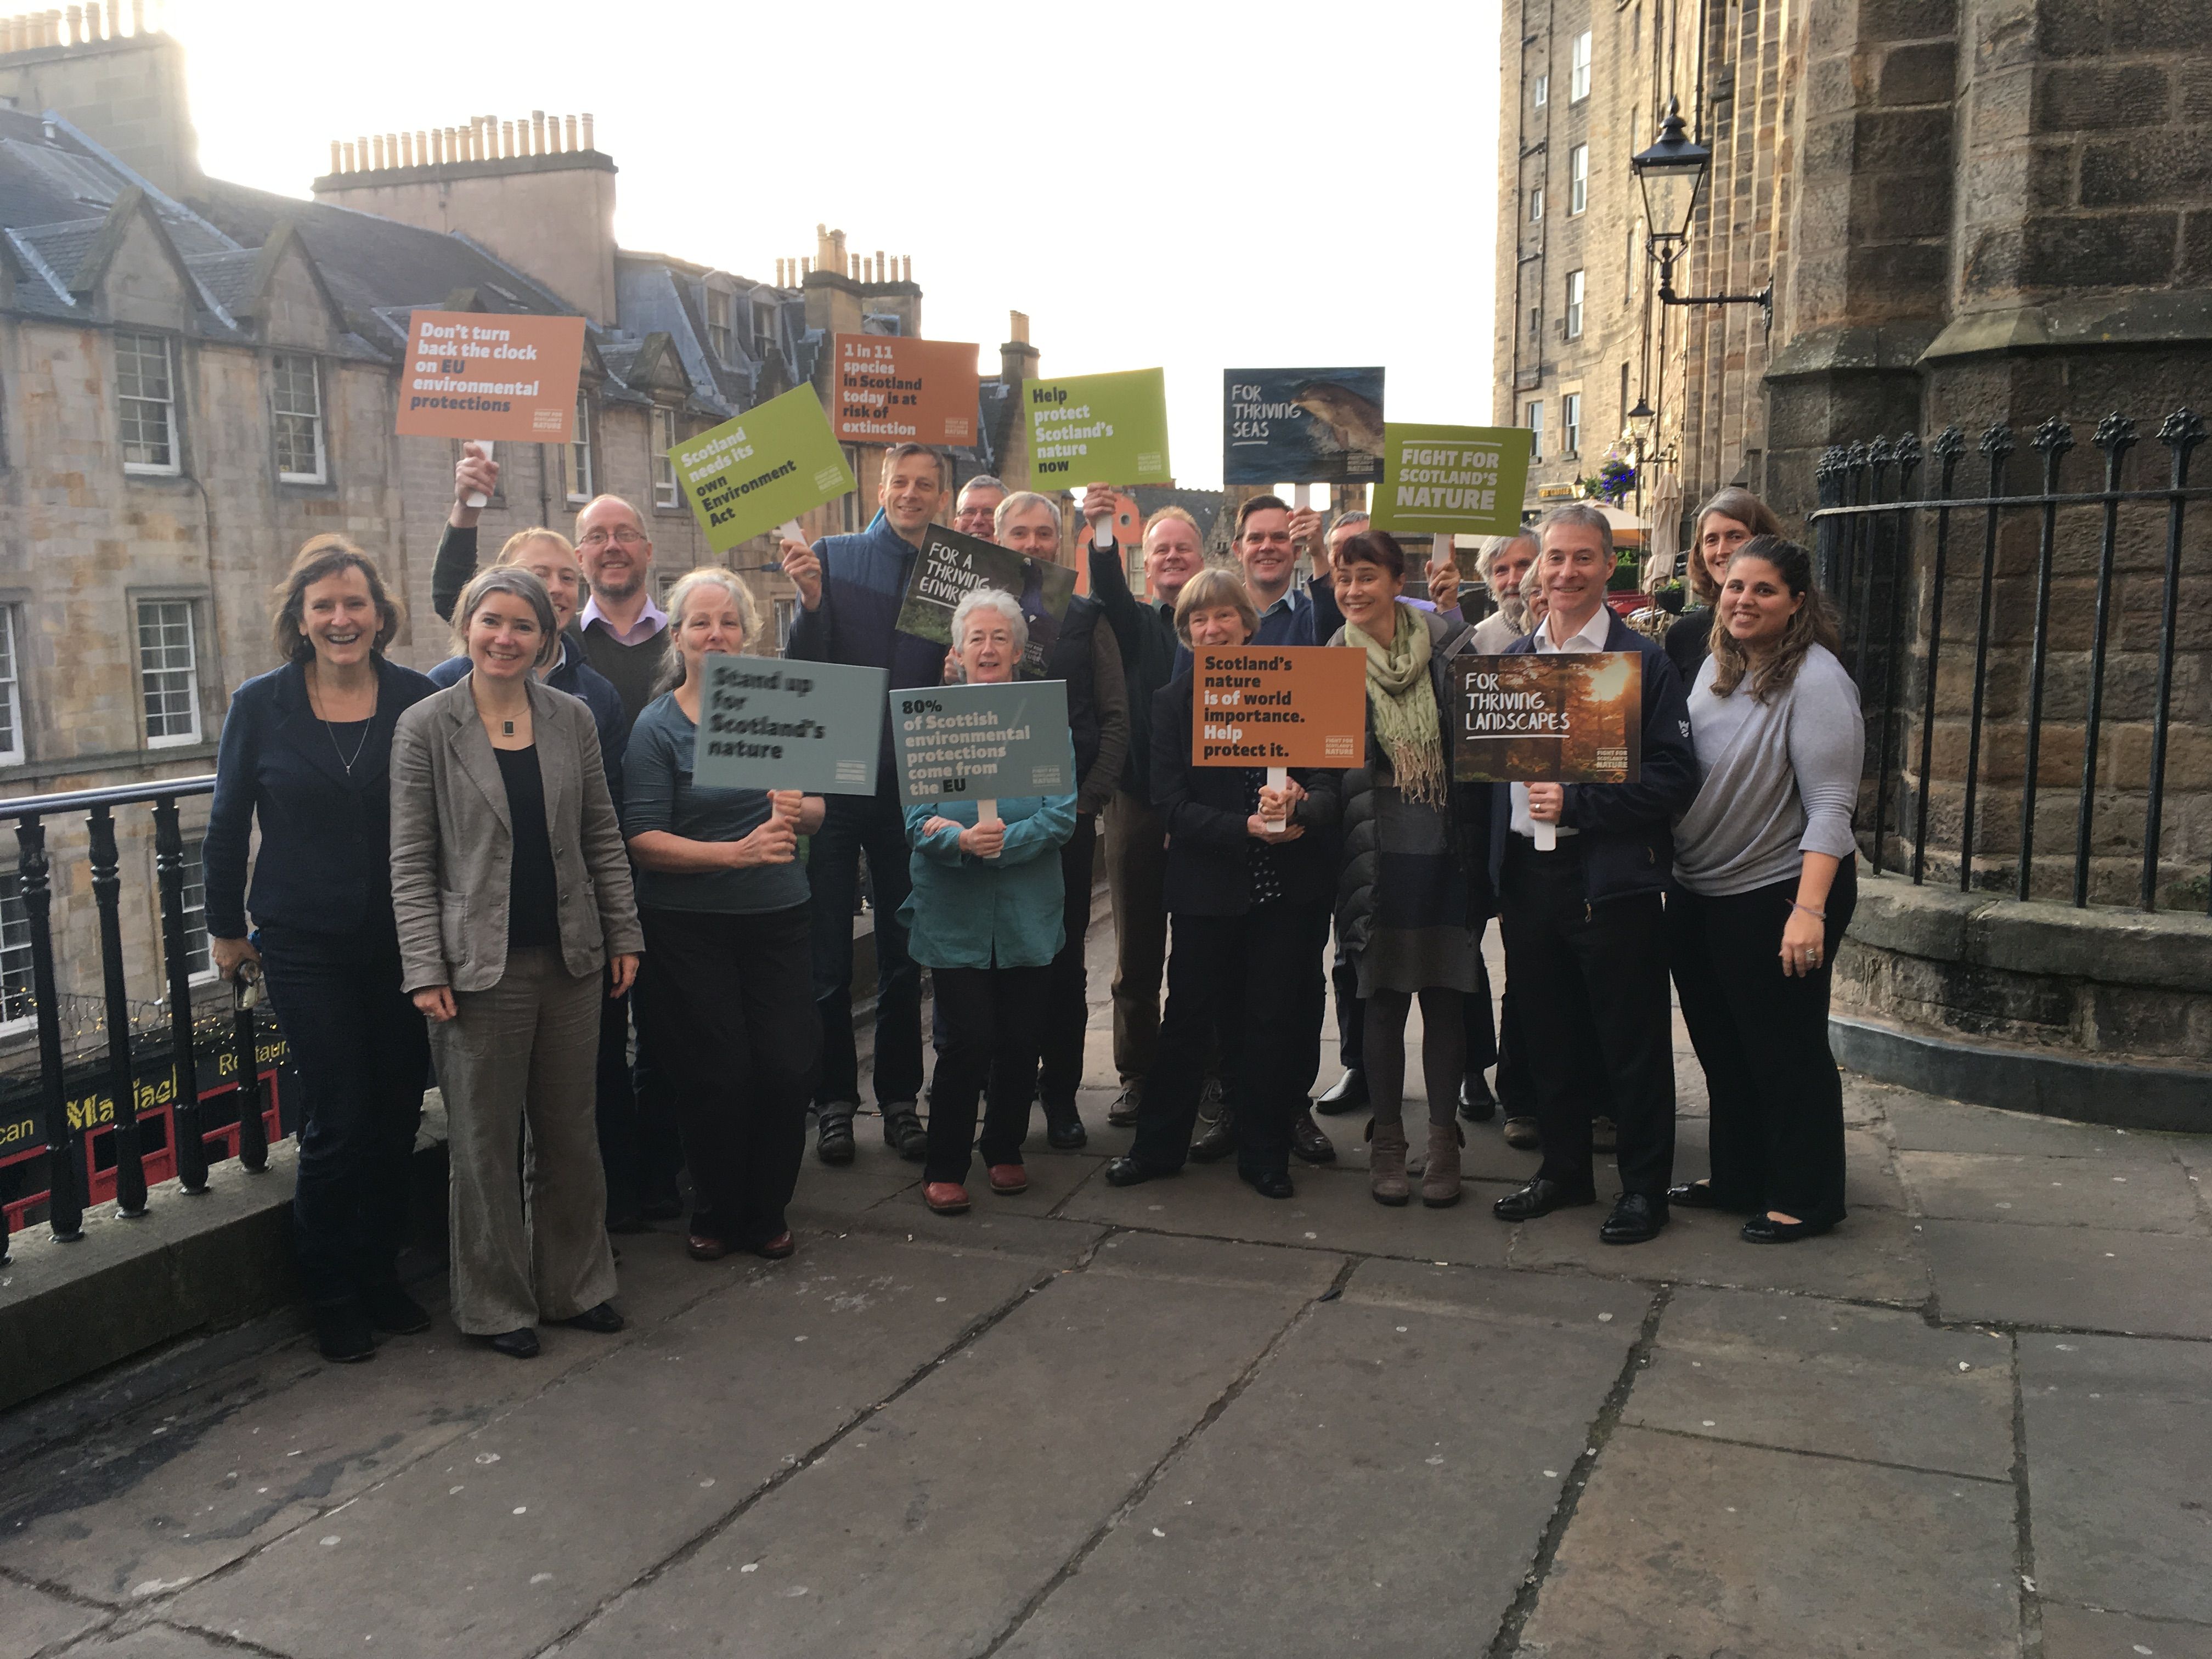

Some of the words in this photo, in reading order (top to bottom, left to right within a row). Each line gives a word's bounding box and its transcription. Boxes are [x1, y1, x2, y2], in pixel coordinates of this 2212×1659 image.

[421, 322, 469, 339] Don't
[472, 327, 510, 341] turn
[418, 340, 457, 356] back
[461, 342, 489, 358] the
[493, 345, 537, 360] clock
[845, 344, 854, 357] 1
[857, 344, 871, 358] in
[874, 346, 893, 359] 11
[415, 360, 437, 373] on
[441, 359, 465, 374] EU
[844, 360, 895, 375] species
[413, 377, 539, 396] environmental
[843, 374, 857, 387] in
[860, 375, 922, 391] Scotland
[843, 390, 885, 407] today
[888, 392, 899, 404] is
[902, 394, 917, 405] at
[1033, 386, 1067, 405] Help
[1232, 385, 1262, 402] FOR
[410, 396, 510, 412] protections
[843, 405, 870, 417] risk
[873, 406, 889, 419] of
[1232, 403, 1301, 420] THRIVING
[1035, 404, 1090, 426] protect
[842, 420, 916, 436] extinction
[1036, 422, 1114, 442] Scotland's
[1232, 421, 1269, 437] SEAS
[681, 426, 747, 467] Scotland
[1037, 444, 1087, 459] nature
[689, 455, 732, 483] needs
[731, 444, 754, 462] its
[1039, 460, 1069, 473] now
[1401, 449, 1458, 466] FIGHT
[1462, 451, 1499, 469] FOR
[696, 475, 728, 496] own
[702, 460, 797, 512] Environment
[1400, 469, 1498, 486] SCOTLAND'S
[1396, 486, 1496, 510] NATURE
[709, 507, 736, 527] Act
[928, 542, 960, 566] FOR
[963, 554, 973, 569] A
[927, 559, 990, 590] THRIVING
[1205, 656, 1293, 670] Scotland's
[713, 667, 783, 690] Stand
[784, 678, 813, 697] up
[1205, 675, 1261, 688] nature
[1466, 673, 1499, 691] FOR
[712, 689, 747, 710] for
[902, 699, 943, 714] 80%
[1204, 690, 1218, 705] is
[1221, 690, 1240, 705] of
[1244, 691, 1291, 705] world
[1466, 692, 1545, 711] THRIVING
[904, 716, 922, 731] of
[926, 711, 998, 730] Scottish
[1204, 708, 1305, 725] importance.
[1466, 713, 1570, 731] LANDSCAPES
[709, 713, 826, 739] Scotland's
[1204, 725, 1243, 743] Help
[905, 725, 1030, 747] environmental
[708, 741, 783, 759] nature
[907, 745, 1006, 768] protections
[1204, 744, 1268, 760] protect
[1270, 743, 1289, 757] it.
[909, 766, 952, 780] come
[955, 761, 997, 776] from
[910, 781, 939, 795] the
[943, 778, 966, 793] EU
